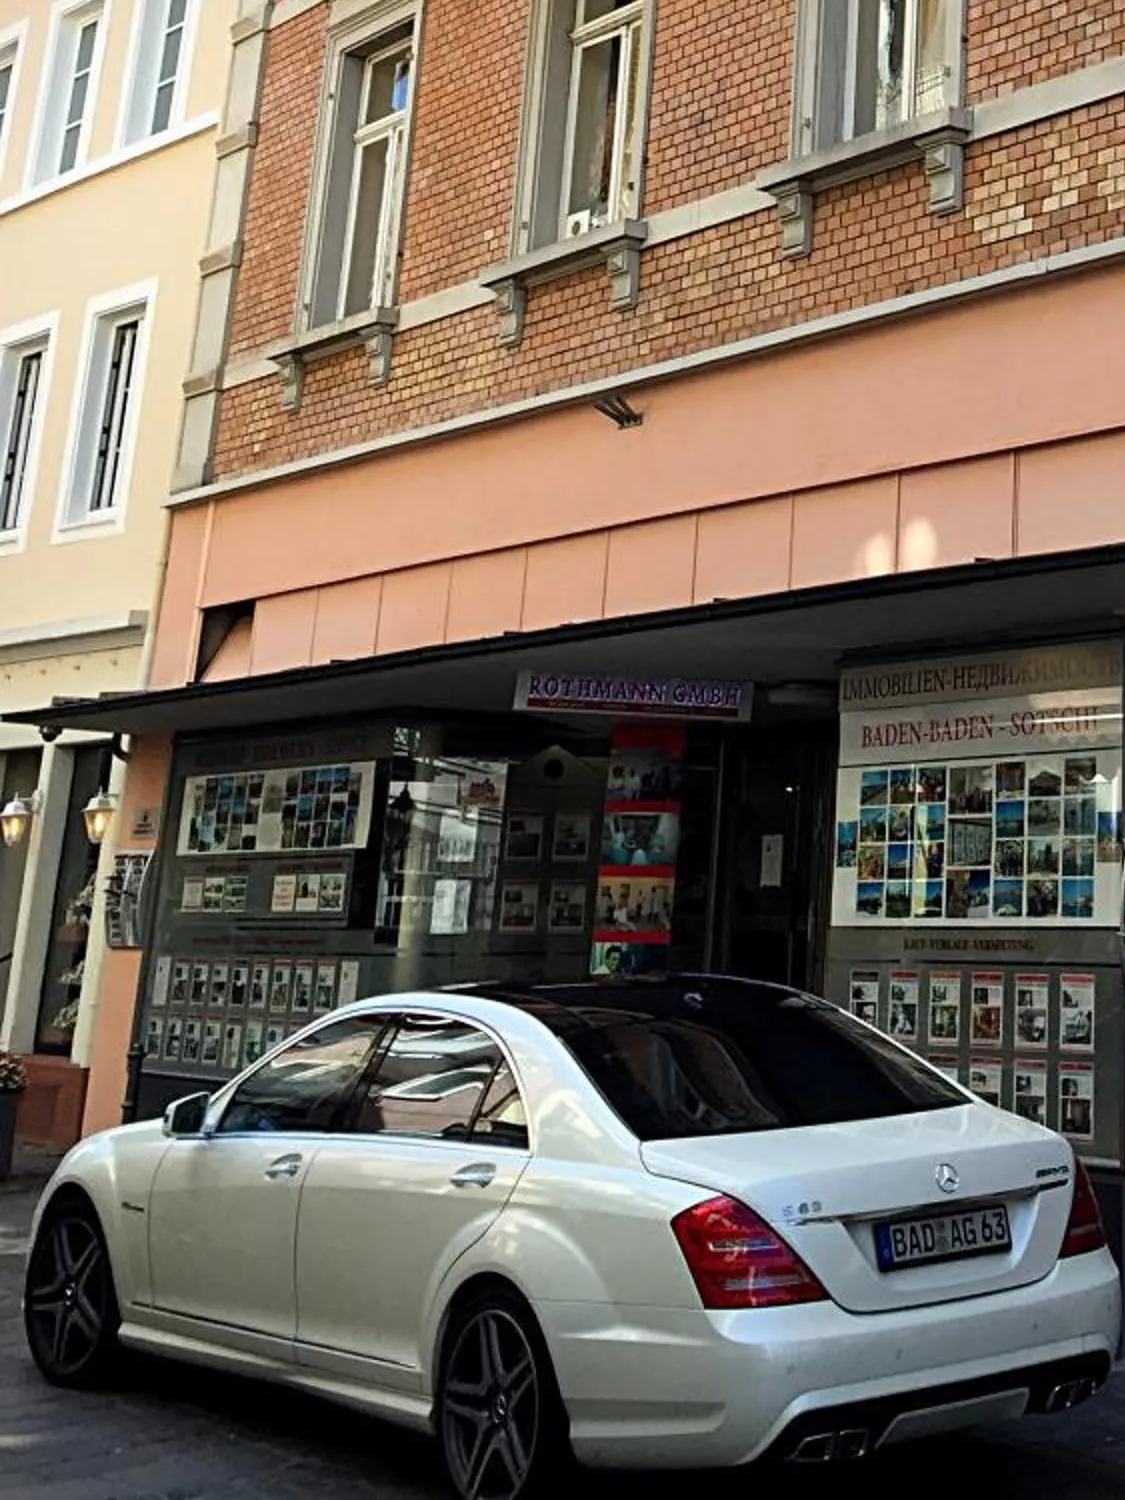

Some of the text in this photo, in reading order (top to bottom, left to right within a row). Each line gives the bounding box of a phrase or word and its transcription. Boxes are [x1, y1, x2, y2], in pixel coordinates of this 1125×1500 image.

[528, 675, 742, 707] ROTHMANN GMBH
[861, 714, 995, 748] BADEN-BADEN
[892, 1211, 1005, 1257] BAD AG 63
